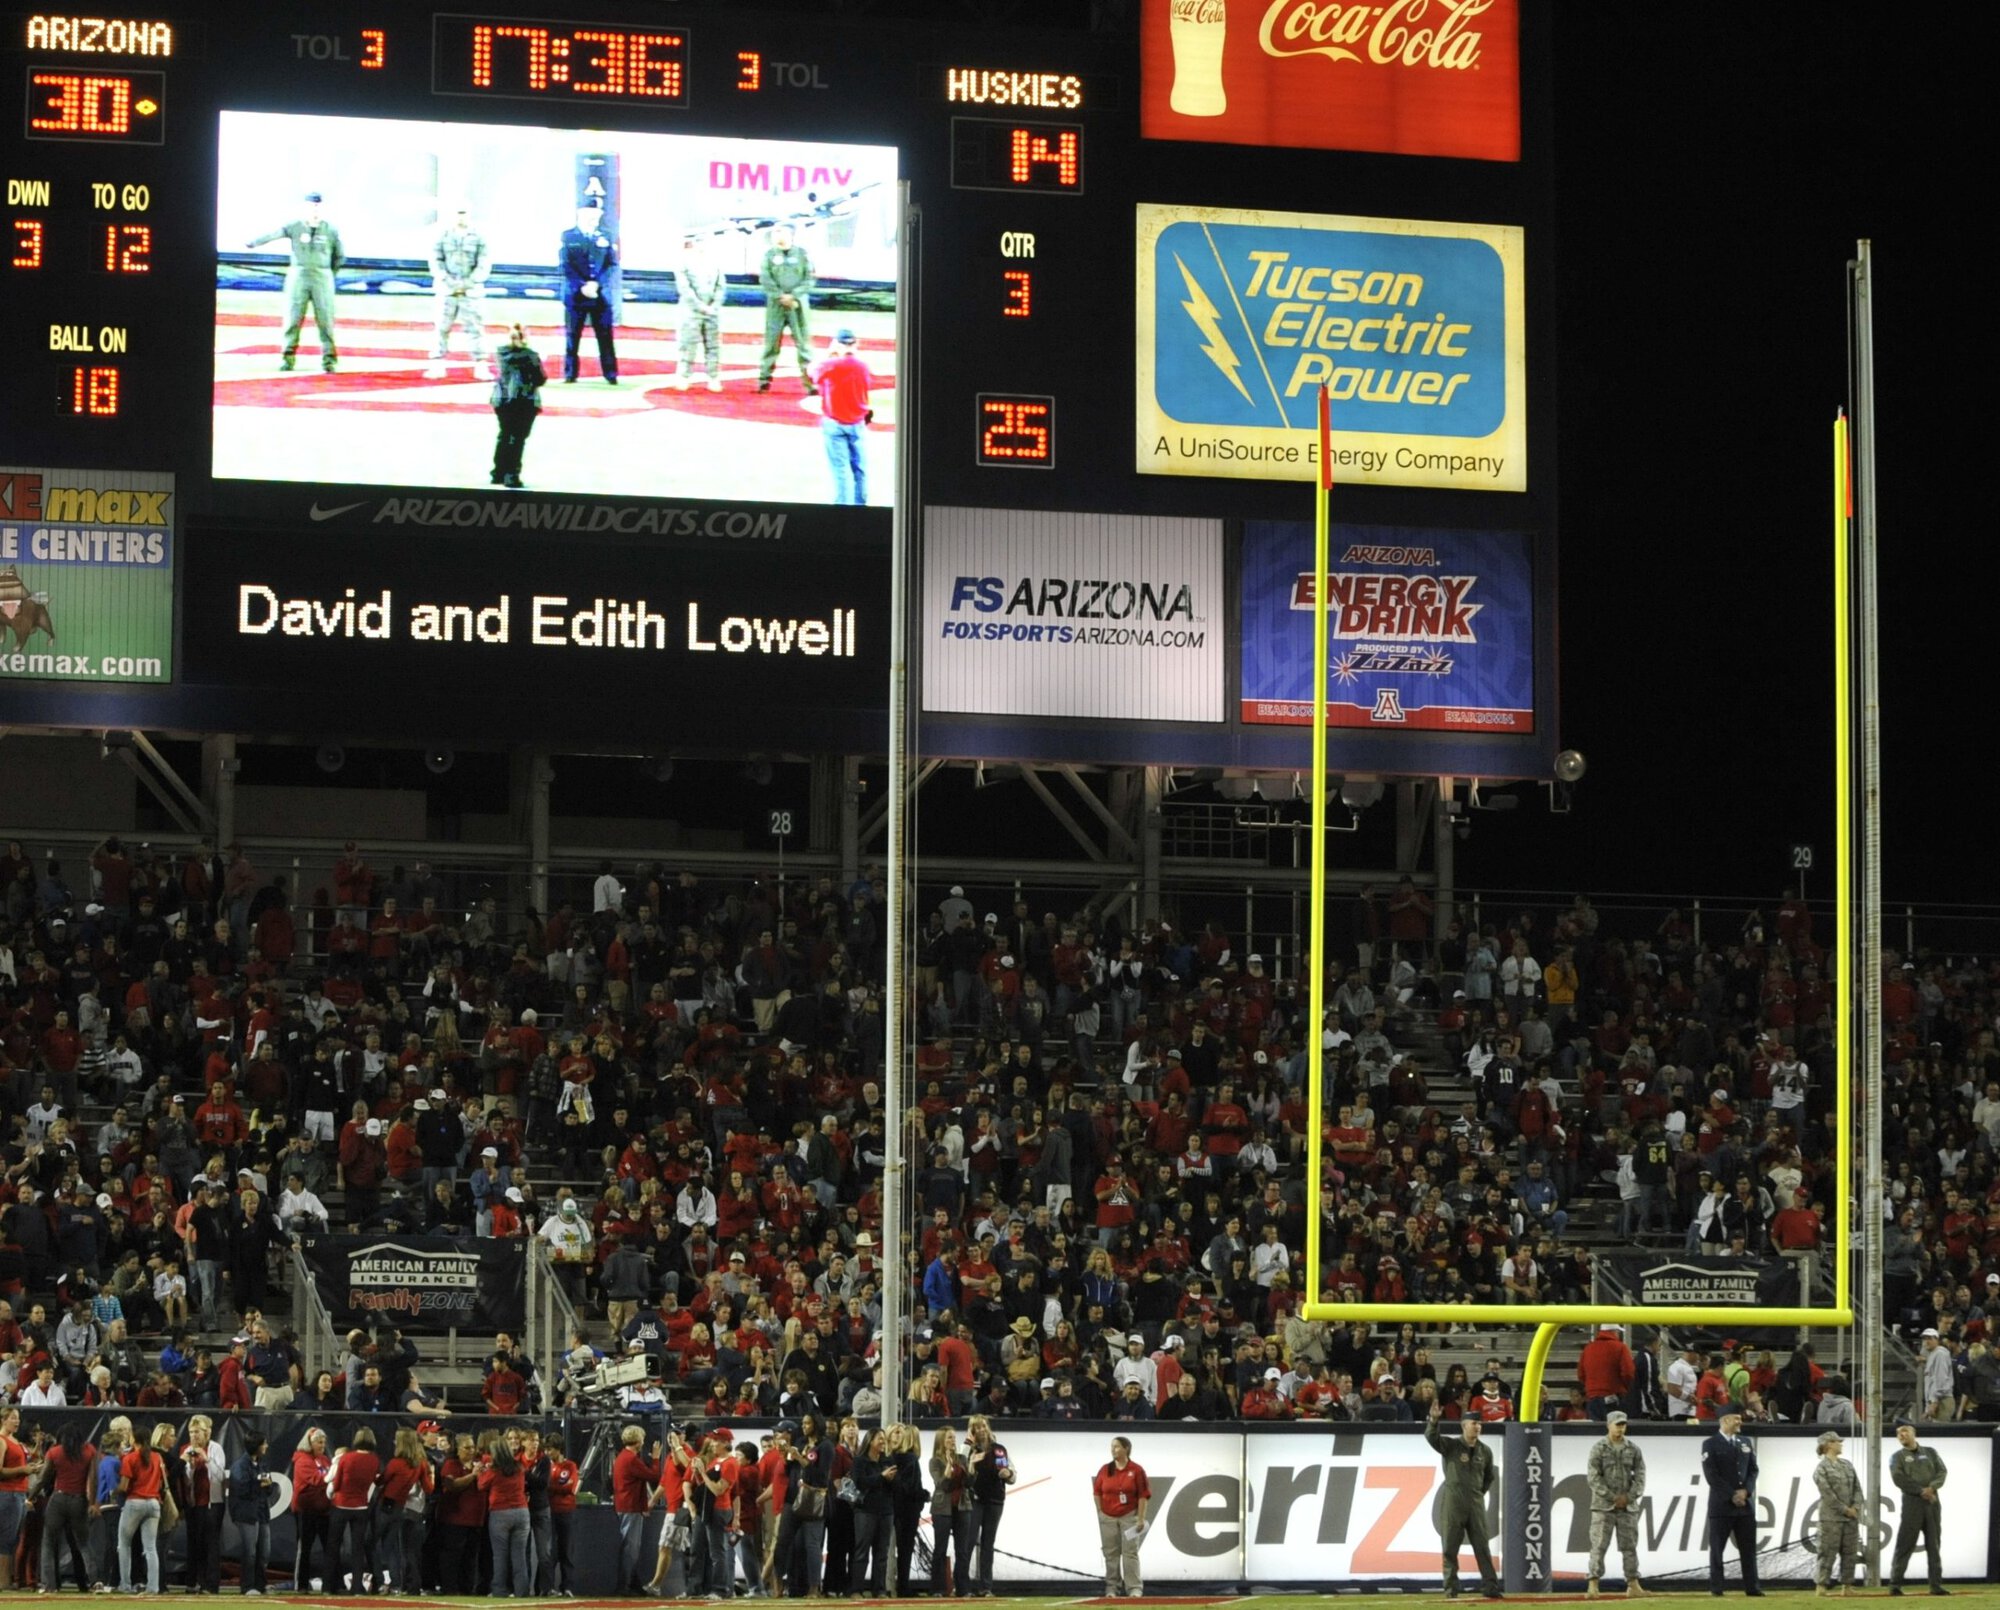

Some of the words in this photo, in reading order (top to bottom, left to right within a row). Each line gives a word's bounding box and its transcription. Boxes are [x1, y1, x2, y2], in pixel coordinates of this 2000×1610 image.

[27, 16, 172, 56] ARIZONA
[291, 34, 350, 61] TOL
[361, 30, 385, 69] 3
[1258, 0, 1494, 70] Coca-Cola
[474, 26, 681, 97] 17:36
[738, 52, 760, 90] 3
[771, 62, 829, 90] TOL
[32, 75, 130, 133] 30
[947, 68, 1082, 108] HUSKIES
[709, 161, 769, 191] DM
[1011, 129, 1077, 185] 14
[8, 180, 50, 207] DWN
[92, 184, 116, 210] TO
[122, 185, 150, 211] GO
[13, 221, 43, 268] 3
[106, 226, 151, 272] 12
[1001, 232, 1035, 259] QTR
[1004, 272, 1031, 317] 3
[1245, 251, 1424, 307] Tucson
[50, 325, 93, 352] BALL
[100, 327, 127, 353] ON
[1263, 302, 1472, 358] Electric
[74, 367, 117, 416] 18
[1284, 353, 1471, 407] Power
[984, 402, 1048, 459] 25
[1155, 436, 1171, 456] A
[1179, 437, 1299, 464] UniSource
[1308, 444, 1388, 472] Energy
[1396, 447, 1505, 480] Company
[45, 487, 173, 526] max
[373, 498, 788, 540] ARIZONAWILDCATS.COM
[31, 528, 165, 564] CENTERS
[1340, 545, 1436, 567] ARIZONA
[1290, 572, 1478, 612] ENERGY
[238, 584, 391, 639] David
[410, 594, 509, 643] and
[532, 595, 666, 650] Edith
[688, 602, 855, 657] Lowell
[1333, 604, 1485, 644] DRINK
[1355, 643, 1408, 654] PRODUCED
[1410, 645, 1425, 654] BY
[771, 812, 792, 835] 28
[1794, 847, 1812, 868] 29
[1499, 1067, 1513, 1085] 10
[1648, 1146, 1668, 1164] 64
[350, 1259, 424, 1272] AMERICAN
[429, 1260, 478, 1274] FAMILY
[360, 1274, 468, 1285] INSURANCE
[1643, 1278, 1710, 1290] AMERICAN
[1713, 1279, 1757, 1291] FAMILY
[1652, 1292, 1747, 1301] INSURANCE
[1525, 1446, 1544, 1580] ARIZONA
[1636, 1474, 1928, 1553] wieles
